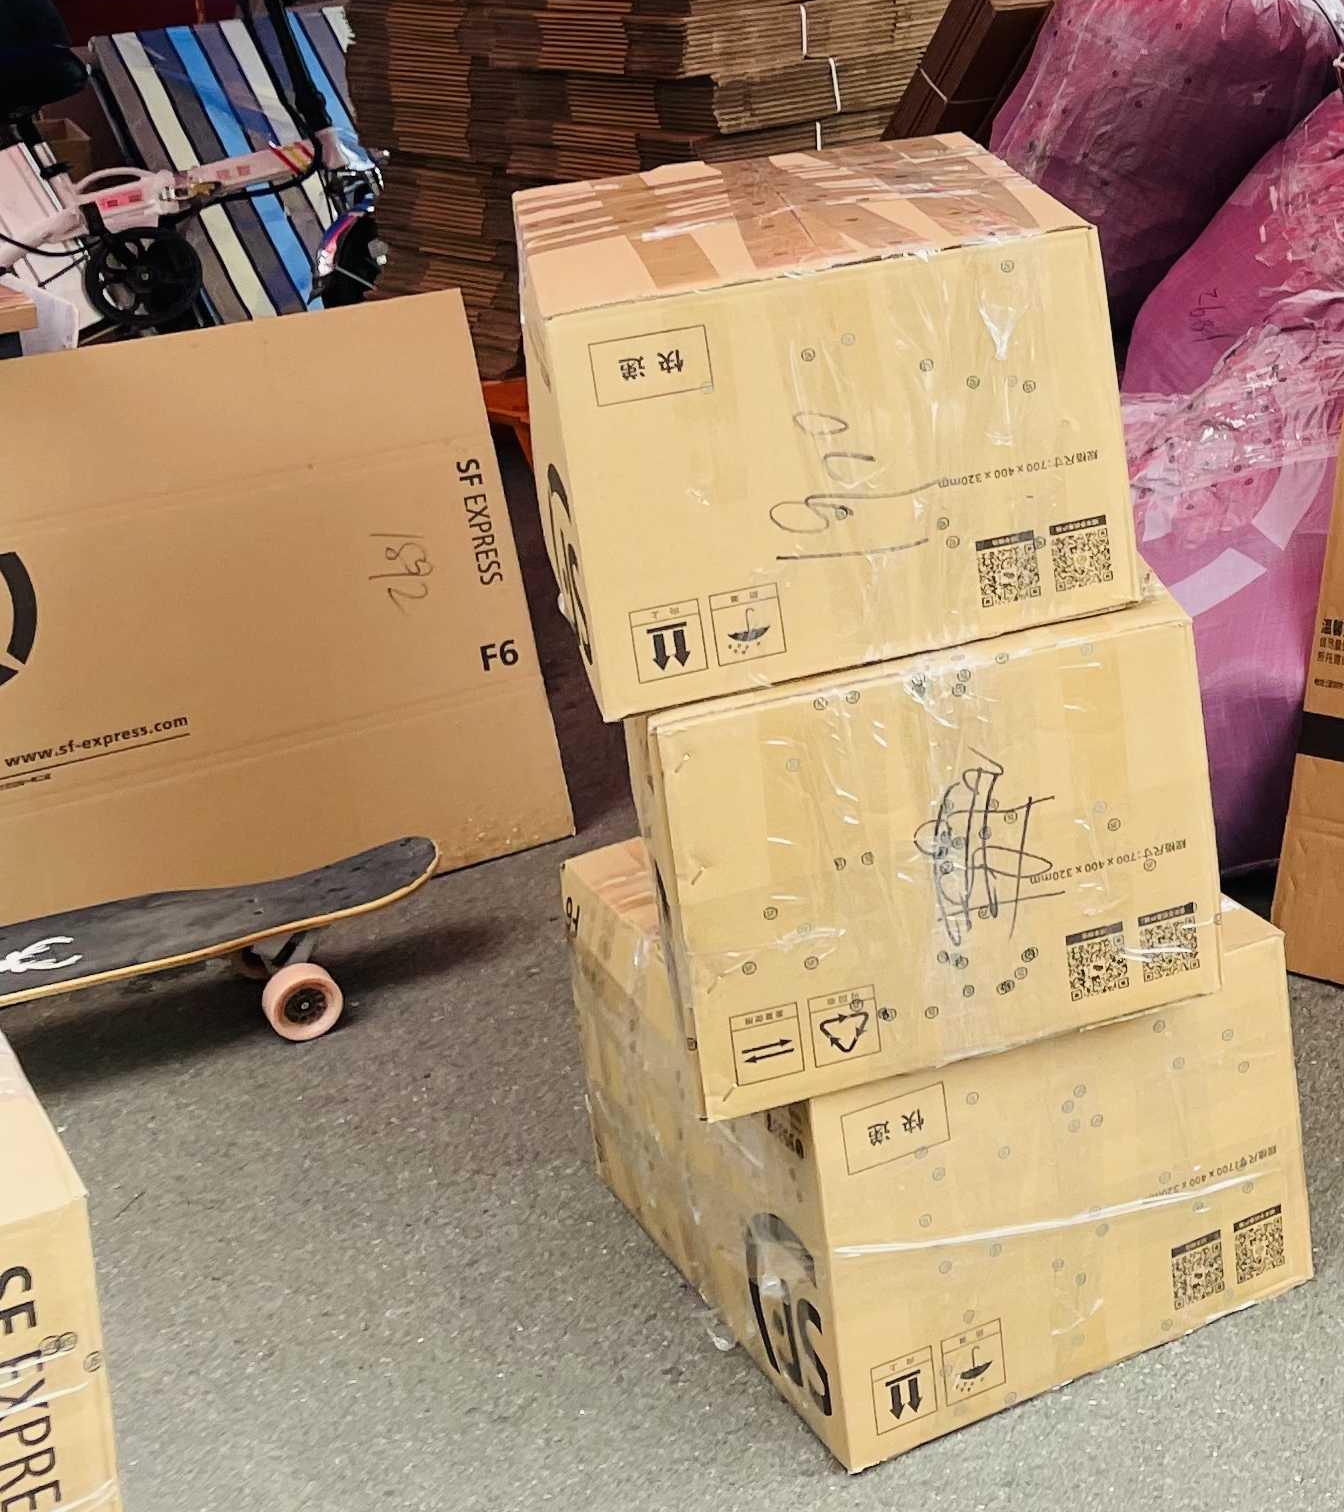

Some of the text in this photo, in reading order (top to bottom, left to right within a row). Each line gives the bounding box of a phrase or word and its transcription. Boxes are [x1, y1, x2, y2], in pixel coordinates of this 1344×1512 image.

[618, 348, 685, 382] 快递
[455, 457, 503, 587] SF EXPRESS
[479, 638, 520, 672] F6
[3, 712, 190, 770] www.sf-express.com
[867, 1107, 926, 1148] 快递
